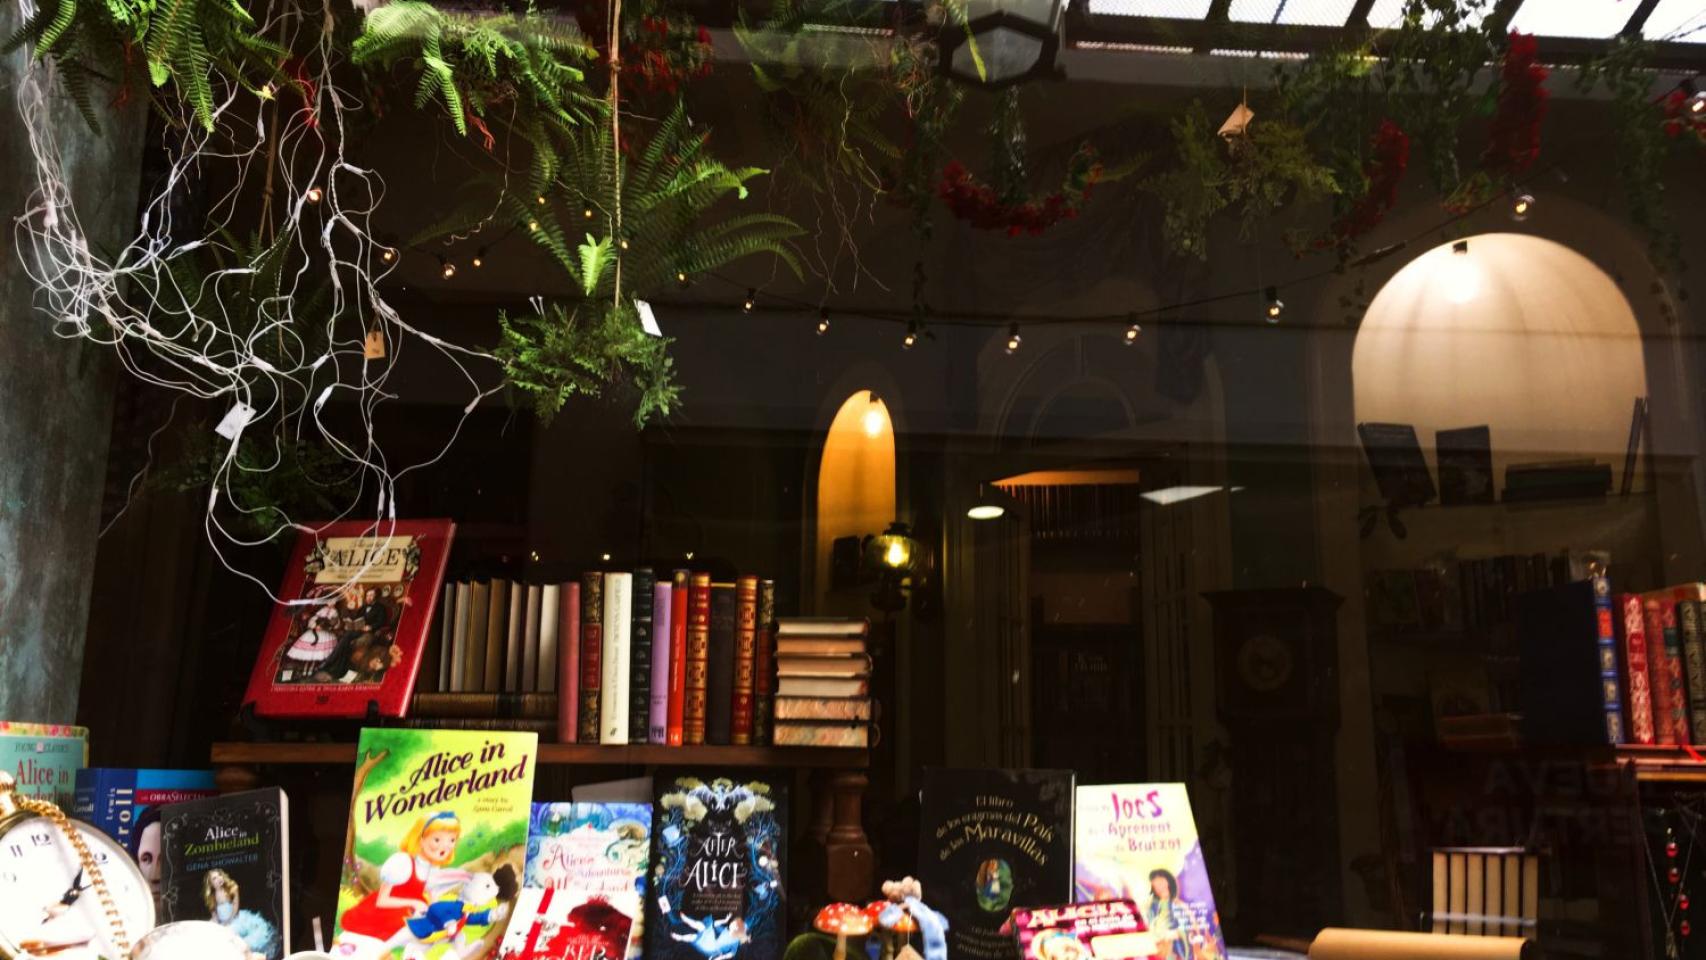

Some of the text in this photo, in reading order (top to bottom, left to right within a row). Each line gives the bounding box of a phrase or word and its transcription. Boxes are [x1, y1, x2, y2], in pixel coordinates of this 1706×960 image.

[15, 758, 69, 785] Alice in
[399, 739, 505, 793] Alice in
[363, 753, 529, 825] Wonderland
[31, 833, 52, 847] 12
[184, 832, 260, 856] Zombieland
[204, 825, 239, 841] Alice
[964, 821, 1048, 866] Maravillas
[211, 853, 259, 868] SHOWALTER
[1027, 901, 1134, 929] ALICIA
